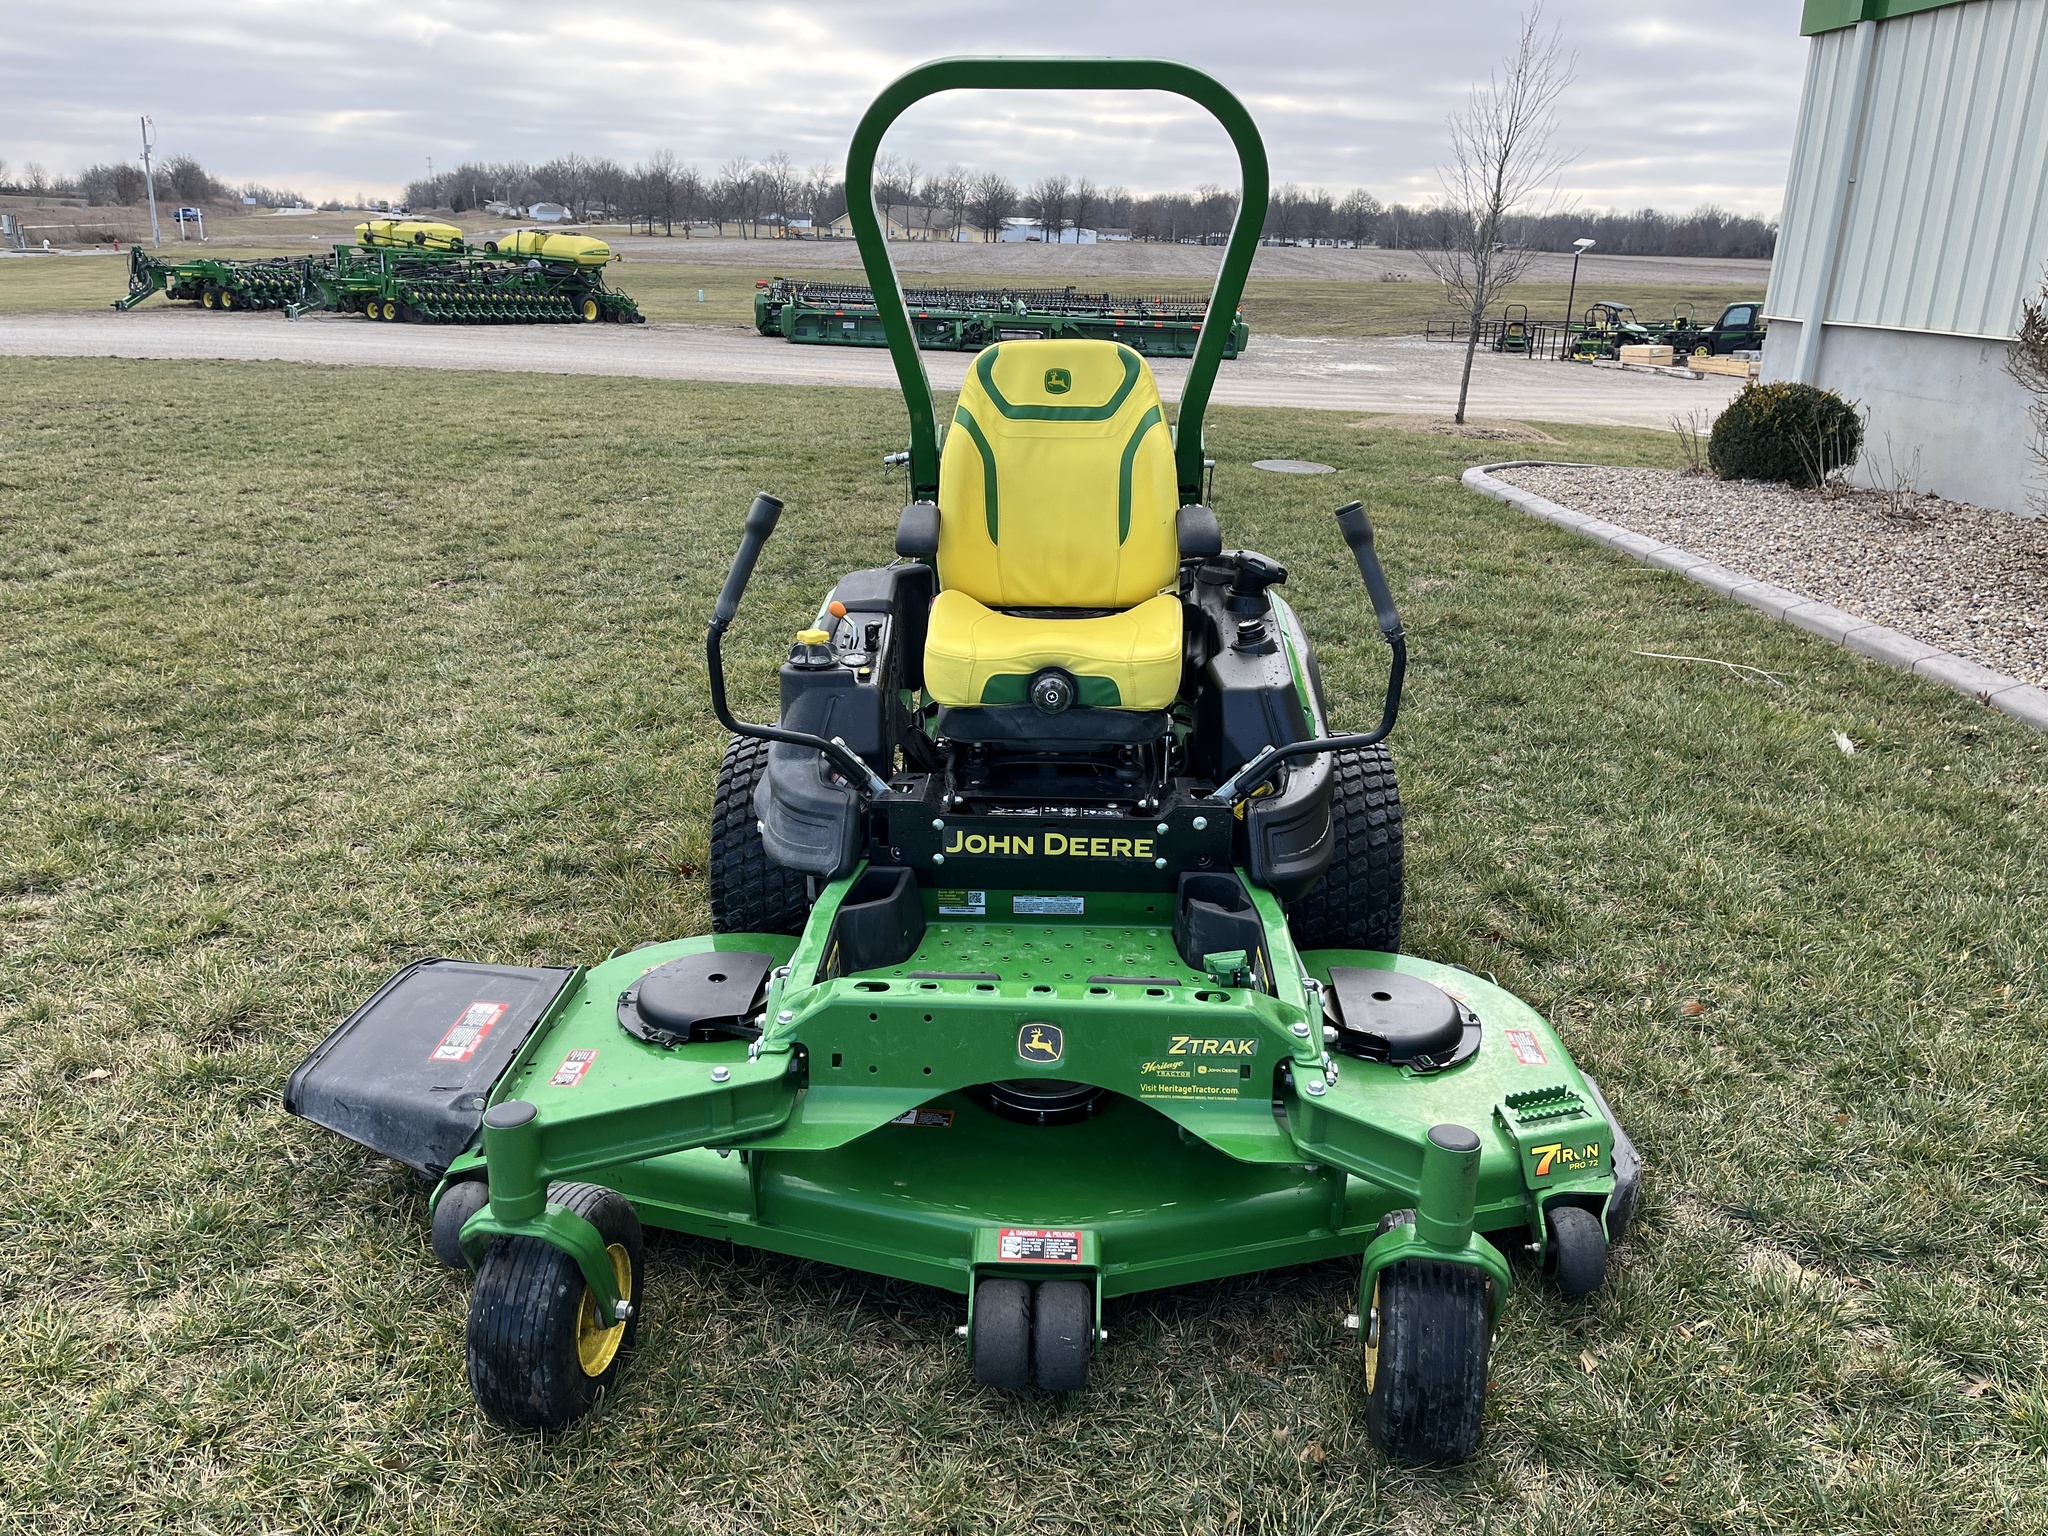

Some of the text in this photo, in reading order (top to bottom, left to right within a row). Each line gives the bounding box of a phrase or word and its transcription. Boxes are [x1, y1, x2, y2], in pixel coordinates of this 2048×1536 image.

[945, 830, 1154, 858] JOHN DEERE
[1168, 1036, 1255, 1055] ZTRAK
[1141, 1059, 1184, 1075] Heritage
[1140, 1084, 1239, 1095] Visit HeritageTractor.com
[1569, 1159, 1599, 1170] PRO 72
